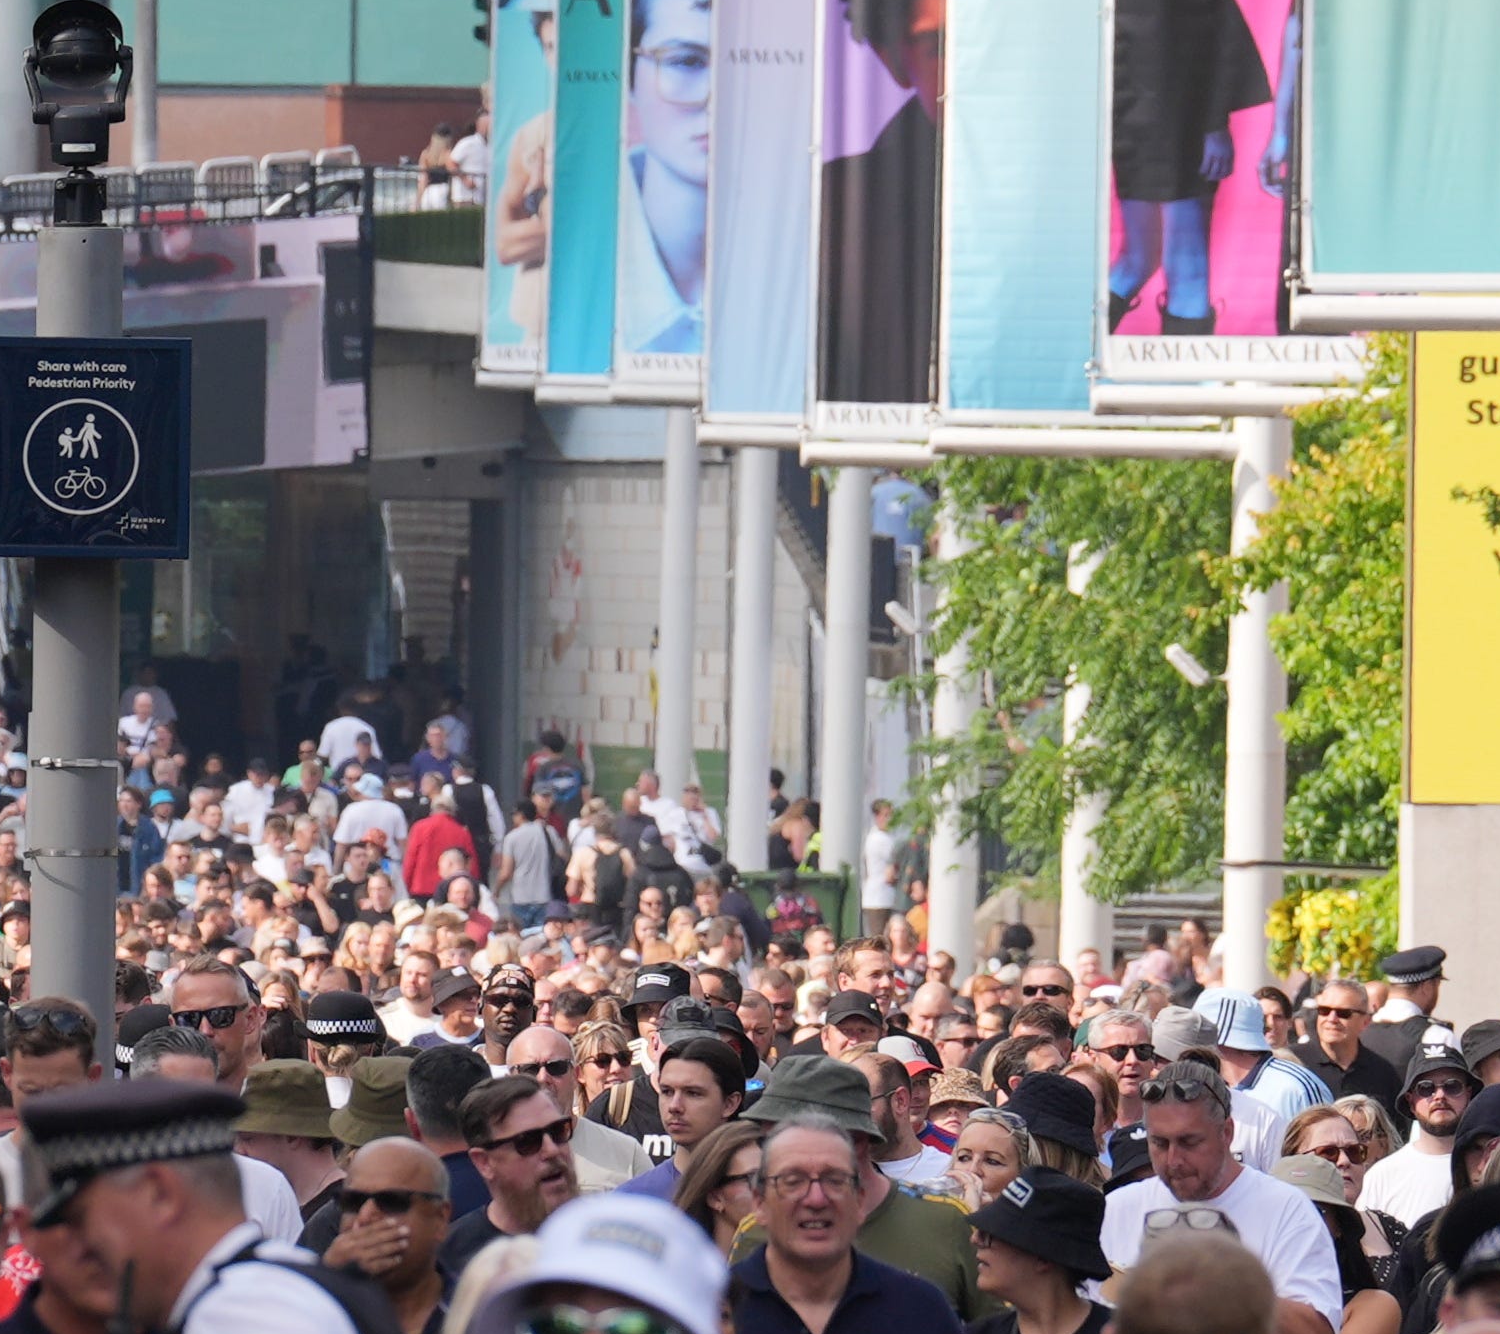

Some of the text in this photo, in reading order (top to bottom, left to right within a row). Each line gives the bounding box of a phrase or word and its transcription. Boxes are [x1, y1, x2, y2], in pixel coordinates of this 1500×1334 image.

[728, 48, 805, 66] ARMANI
[1123, 340, 1230, 363] ARMANI
[37, 360, 128, 372] Share with care
[28, 375, 136, 391] Pedestrian Priority
[824, 406, 914, 427] ARMANI
